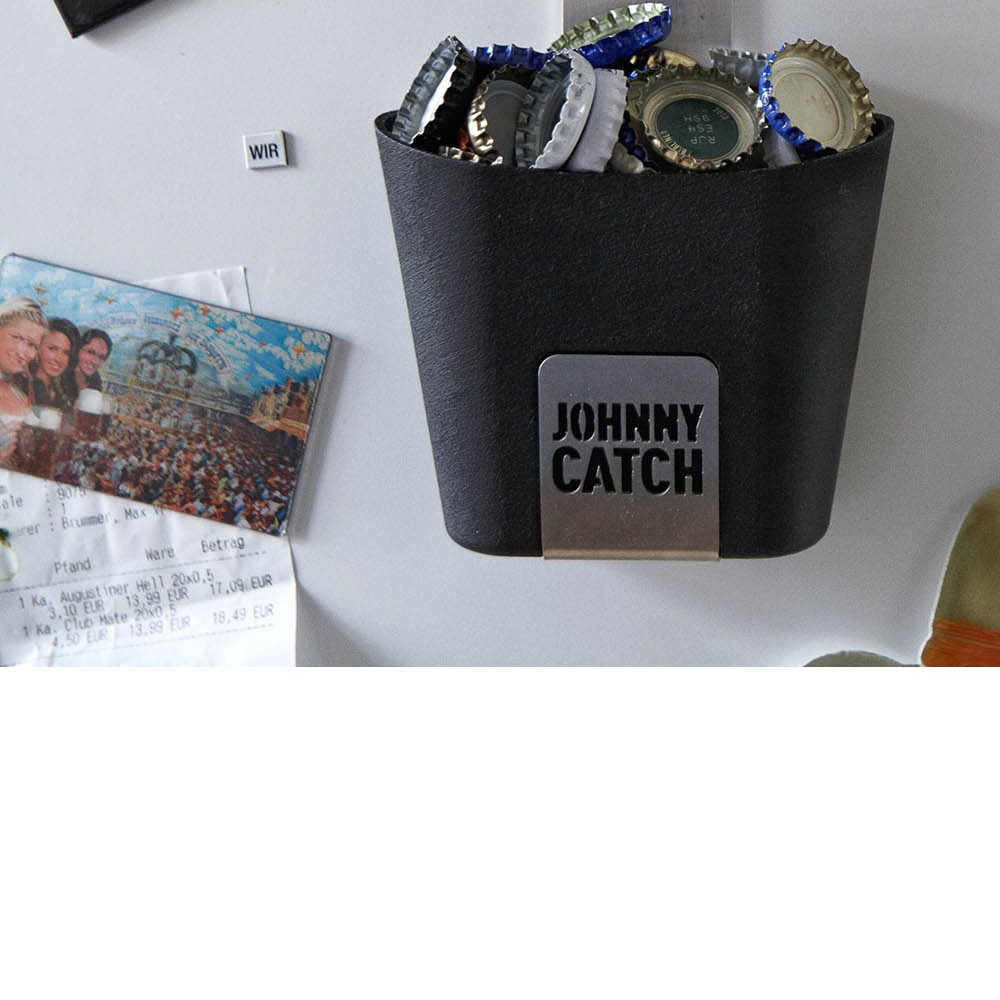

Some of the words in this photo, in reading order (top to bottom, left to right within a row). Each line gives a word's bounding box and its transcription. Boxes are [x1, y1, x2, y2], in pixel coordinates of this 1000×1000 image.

[248, 142, 280, 161] WIR
[552, 401, 704, 443] JOHNNY
[552, 445, 704, 496] CATCH
[83, 598, 105, 615] EUR
[167, 586, 190, 603] EUR
[250, 573, 274, 591] EUR
[135, 574, 166, 593] Hell
[169, 615, 192, 632] EUR
[252, 602, 276, 620] EUR
